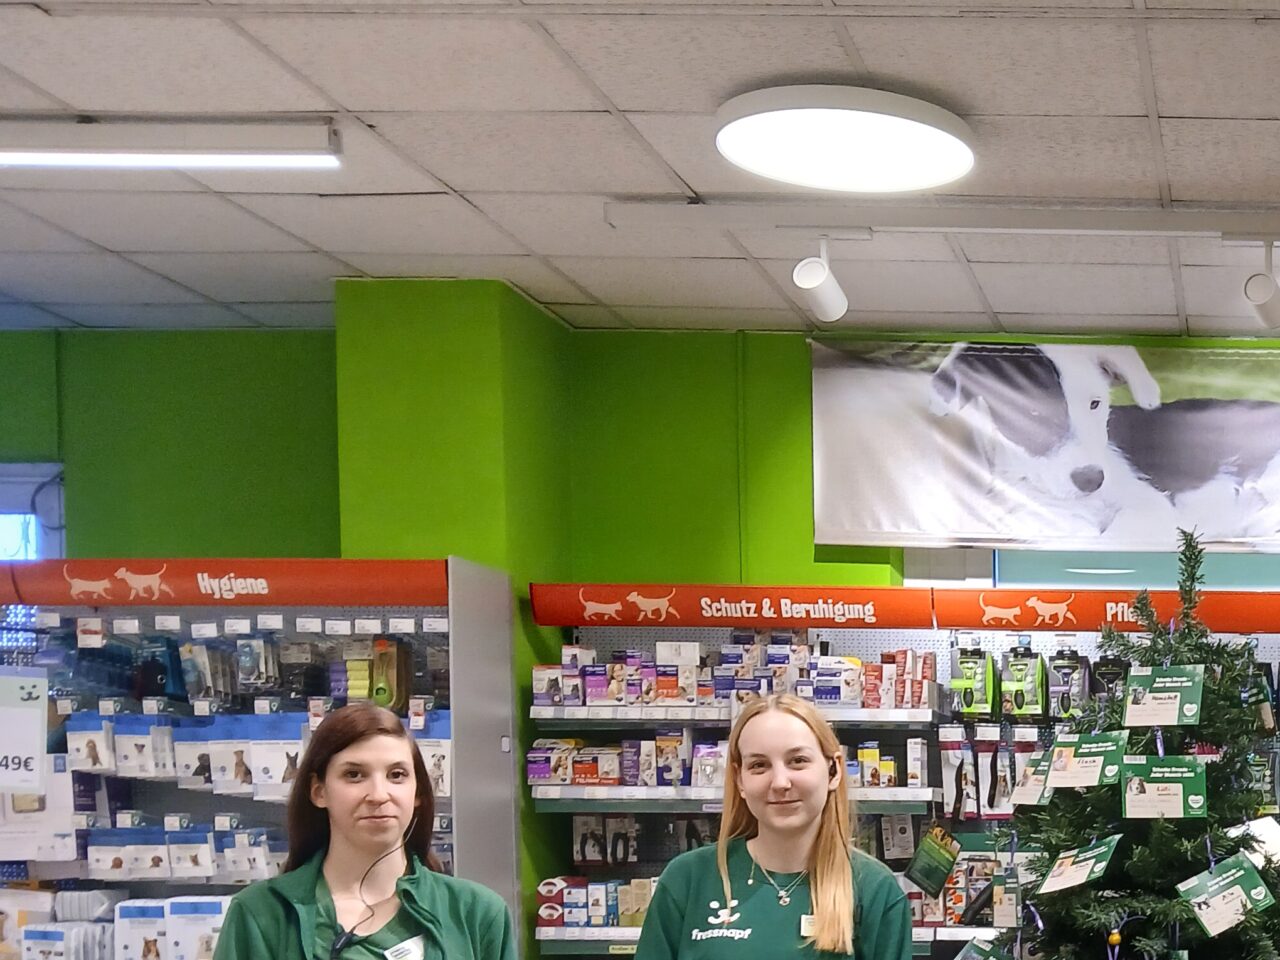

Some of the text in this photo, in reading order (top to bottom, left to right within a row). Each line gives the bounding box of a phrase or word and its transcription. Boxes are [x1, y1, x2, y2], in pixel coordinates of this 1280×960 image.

[197, 573, 268, 598] Hygiene
[700, 598, 876, 623] Schutz & Beruhigung
[1106, 602, 1157, 626] Pfle
[691, 928, 752, 940] fressnapf
